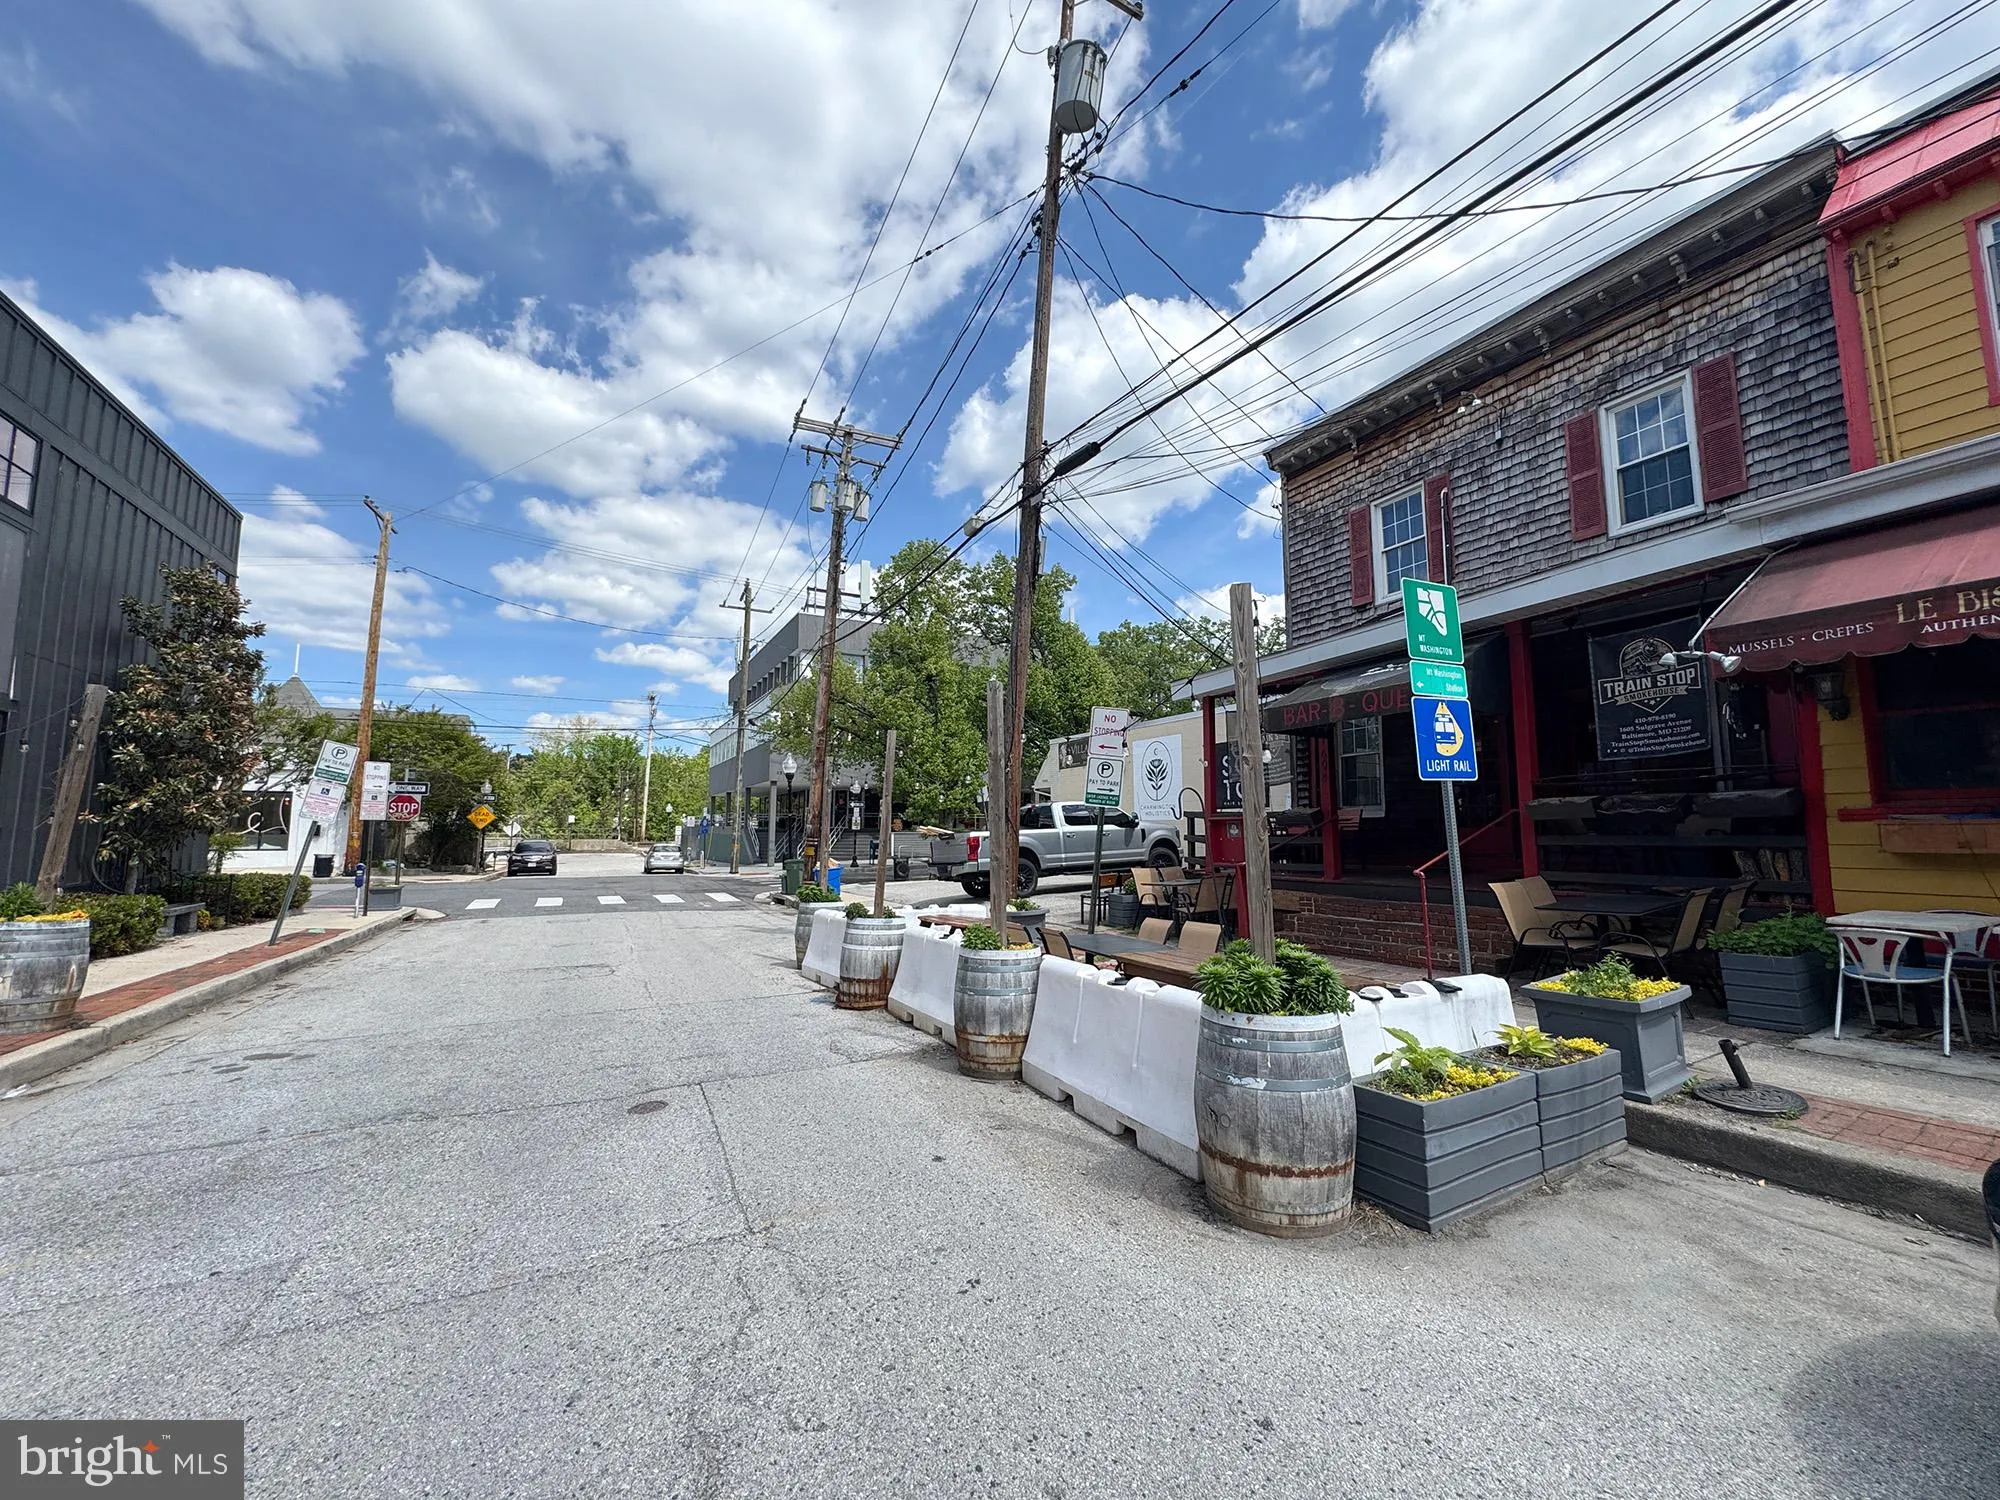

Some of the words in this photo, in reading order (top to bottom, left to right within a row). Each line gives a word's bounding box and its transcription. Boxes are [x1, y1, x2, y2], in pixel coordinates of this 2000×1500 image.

[1896, 597, 1938, 624] LE
[1727, 635, 1795, 655] MUSSELS
[1811, 622, 1875, 642] CREPES
[1419, 644, 1453, 656] WASHINGTON
[1434, 668, 1462, 681] Washington
[1603, 677, 1652, 698] TRAIN
[1656, 667, 1696, 686] STOP
[1623, 687, 1679, 703] SMOKEHOUSE
[1104, 714, 1117, 723] NO
[1658, 728, 1672, 736] MD
[1426, 759, 1450, 772] LIGHT
[1453, 760, 1473, 773] RAIL
[389, 802, 418, 813] STOP
